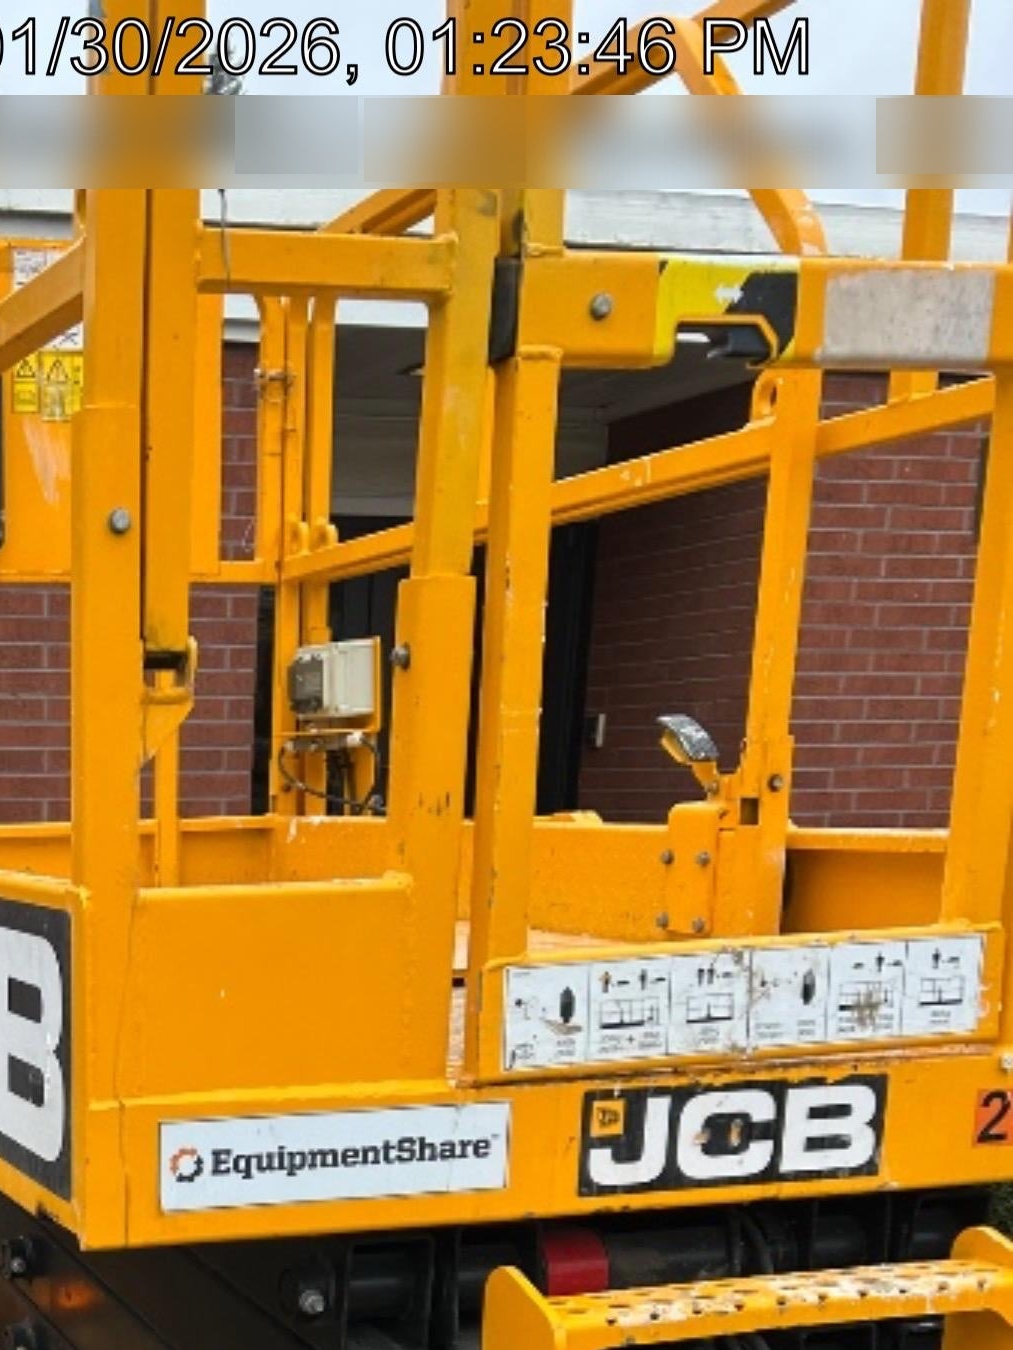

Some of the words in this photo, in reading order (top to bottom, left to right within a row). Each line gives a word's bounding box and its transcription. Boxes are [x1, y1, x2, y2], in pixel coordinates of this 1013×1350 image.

[589, 1085, 877, 1186] JCB
[977, 1091, 1010, 1143] 2
[211, 1136, 491, 1180] EquipmentShare
